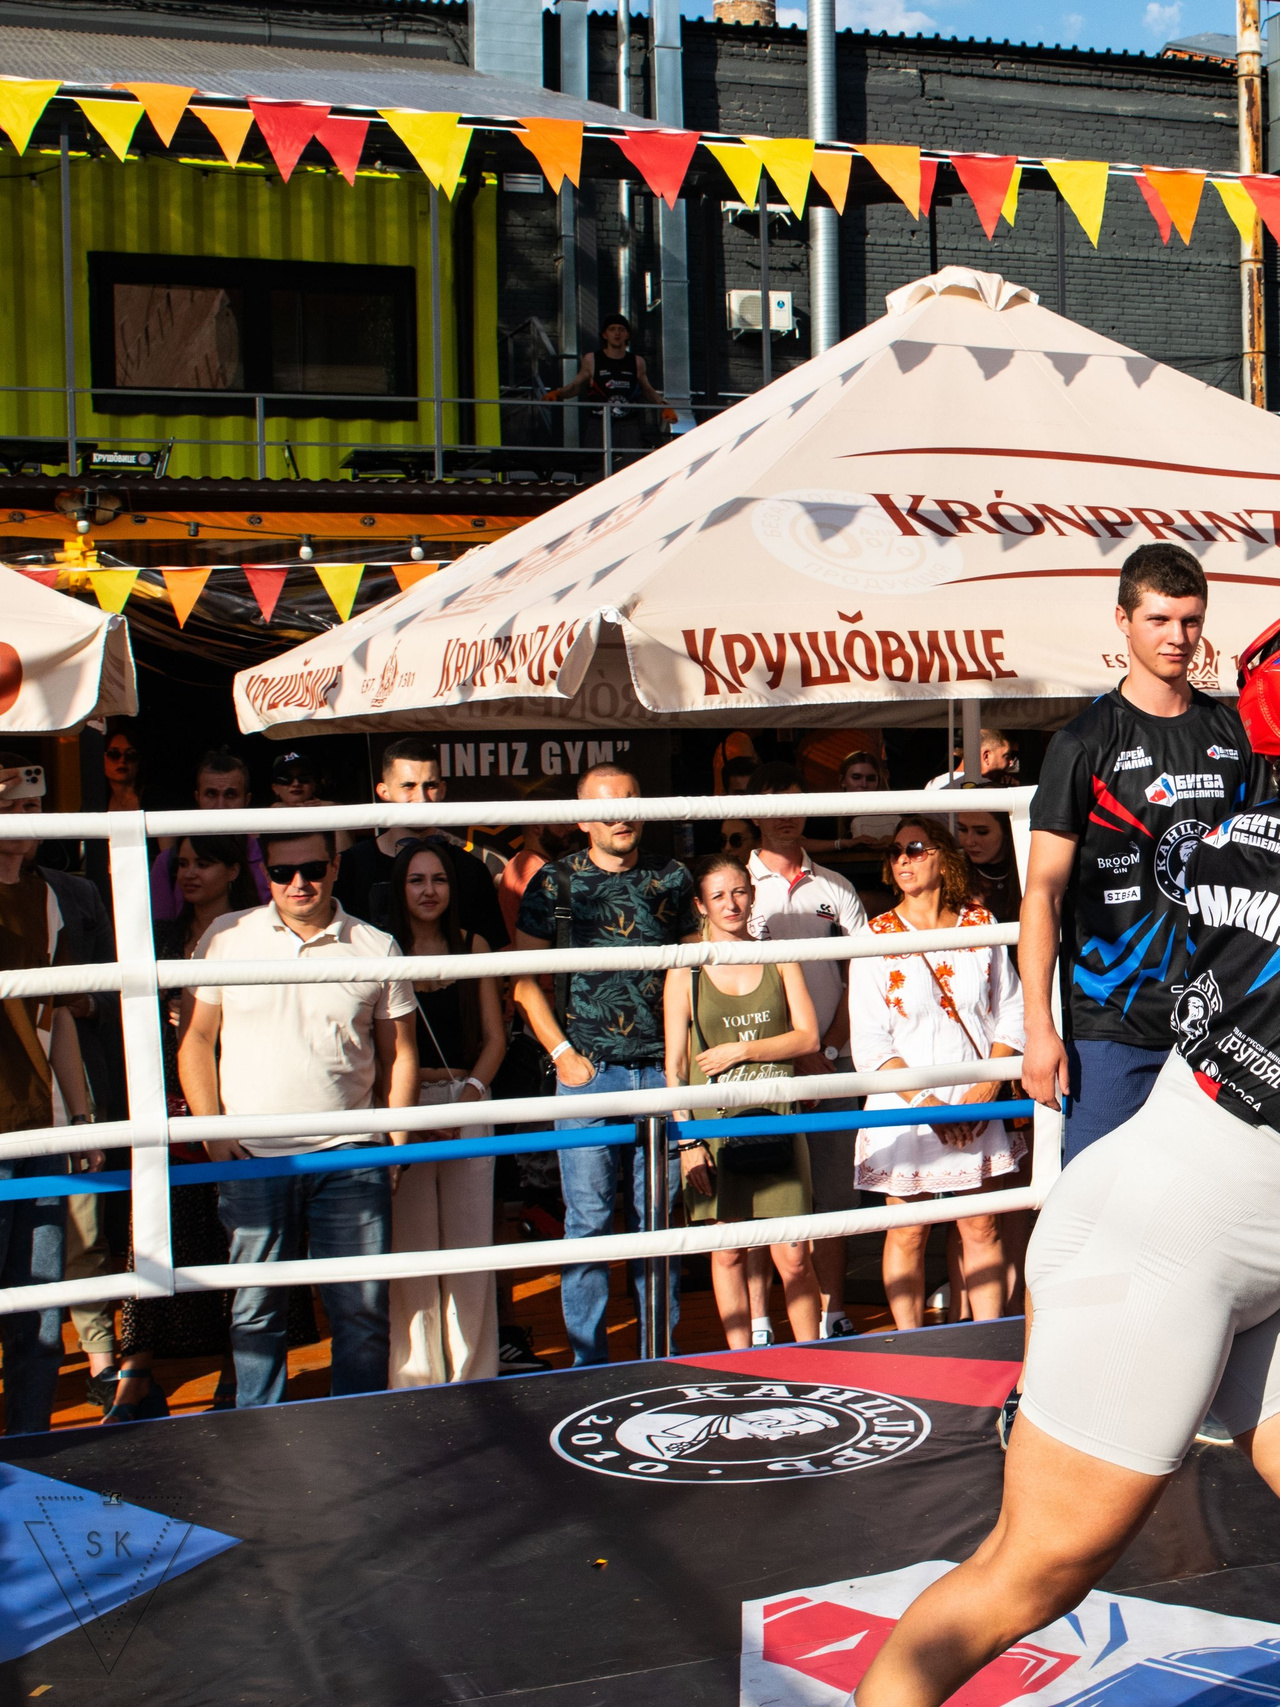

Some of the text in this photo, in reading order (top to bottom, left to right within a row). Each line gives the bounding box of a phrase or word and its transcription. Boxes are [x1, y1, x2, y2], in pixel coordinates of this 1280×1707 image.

[1102, 653, 1129, 669] ES
[1174, 773, 1225, 790] БИТВА
[1097, 852, 1141, 869] BROOM
[738, 1029, 758, 1042] MY
[676, 1384, 916, 1473] КАНЦЛЕРЪ
